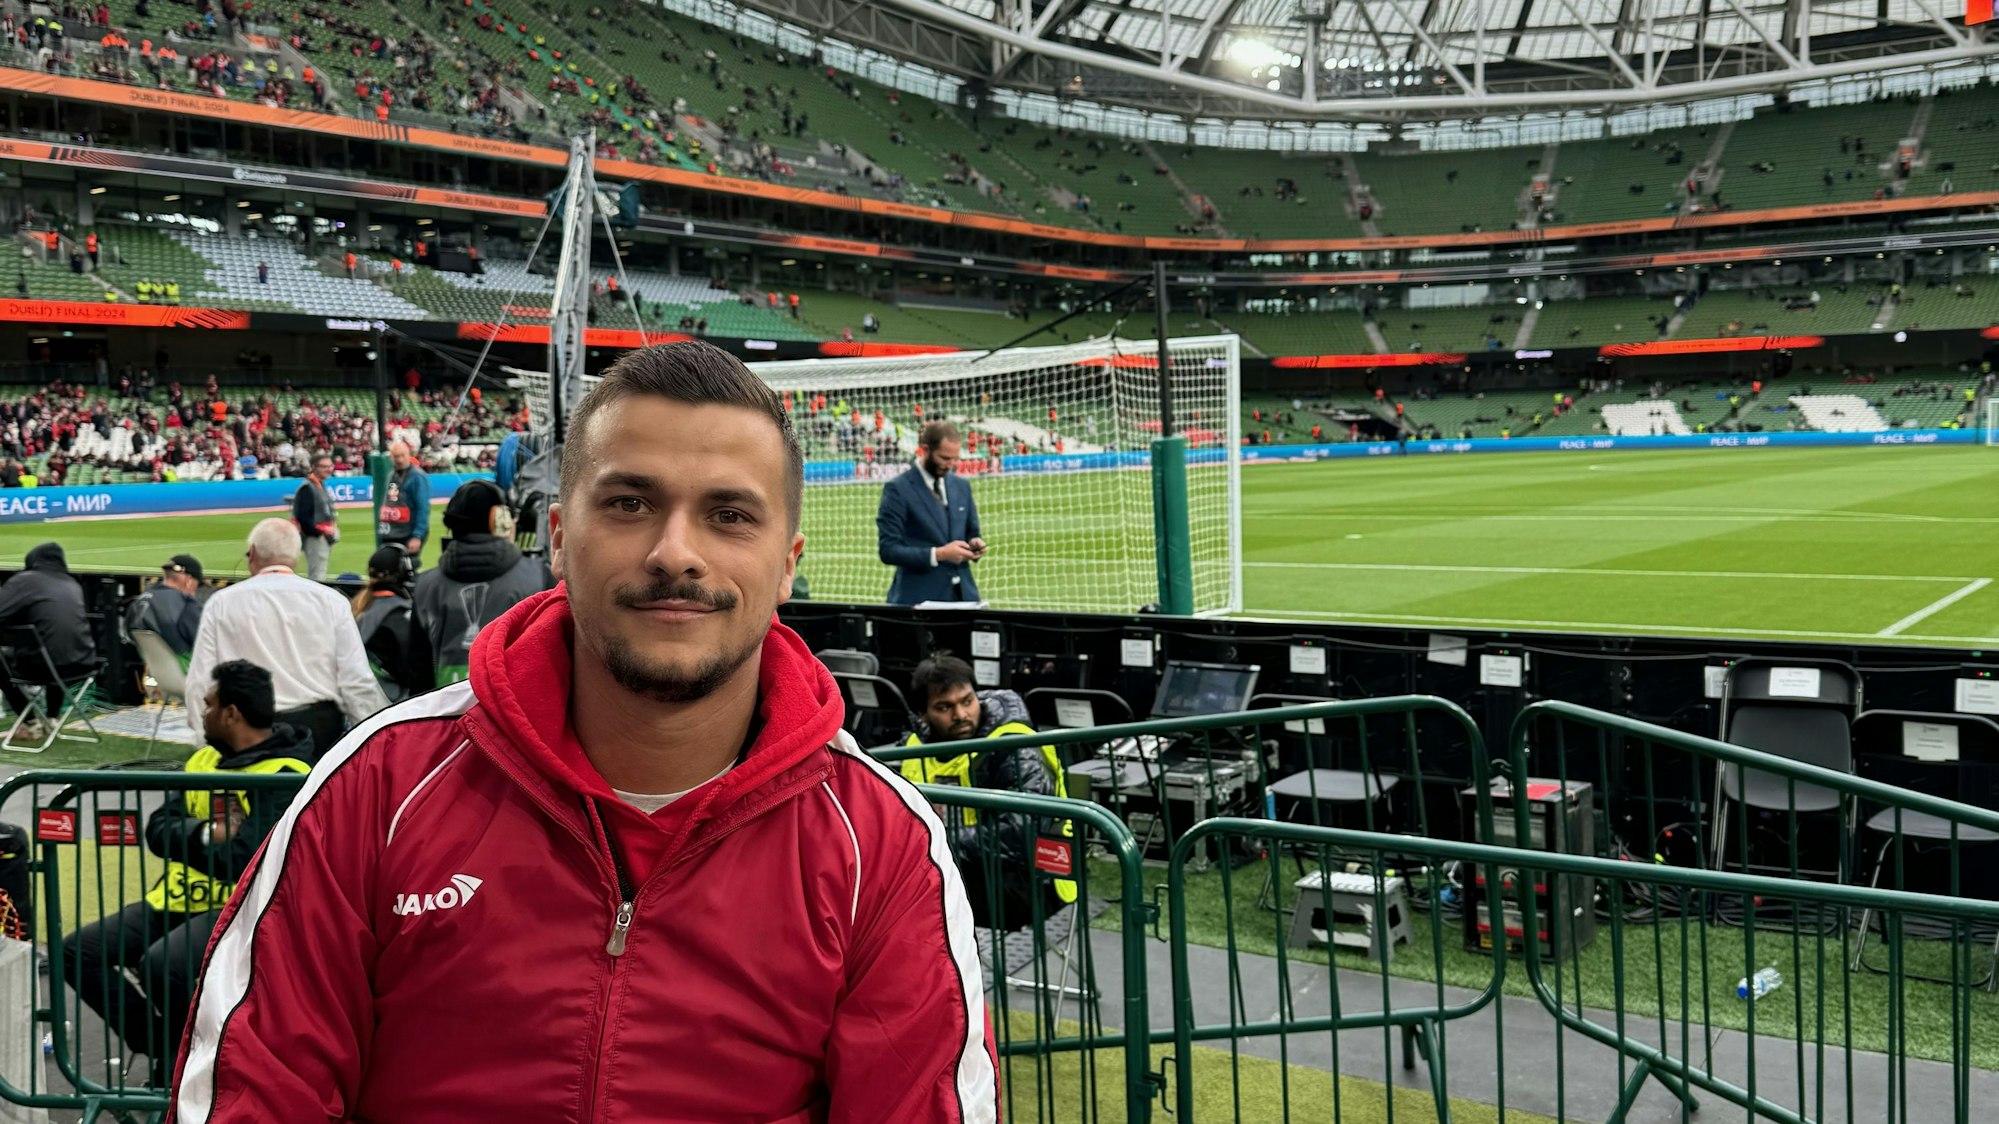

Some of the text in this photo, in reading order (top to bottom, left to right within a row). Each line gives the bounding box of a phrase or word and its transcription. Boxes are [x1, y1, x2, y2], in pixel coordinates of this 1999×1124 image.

[9, 303, 126, 319] DUBLIN FINAL 2024
[326, 484, 355, 501] ACE
[0, 495, 49, 516] EACE
[392, 886, 459, 916] JAKO
